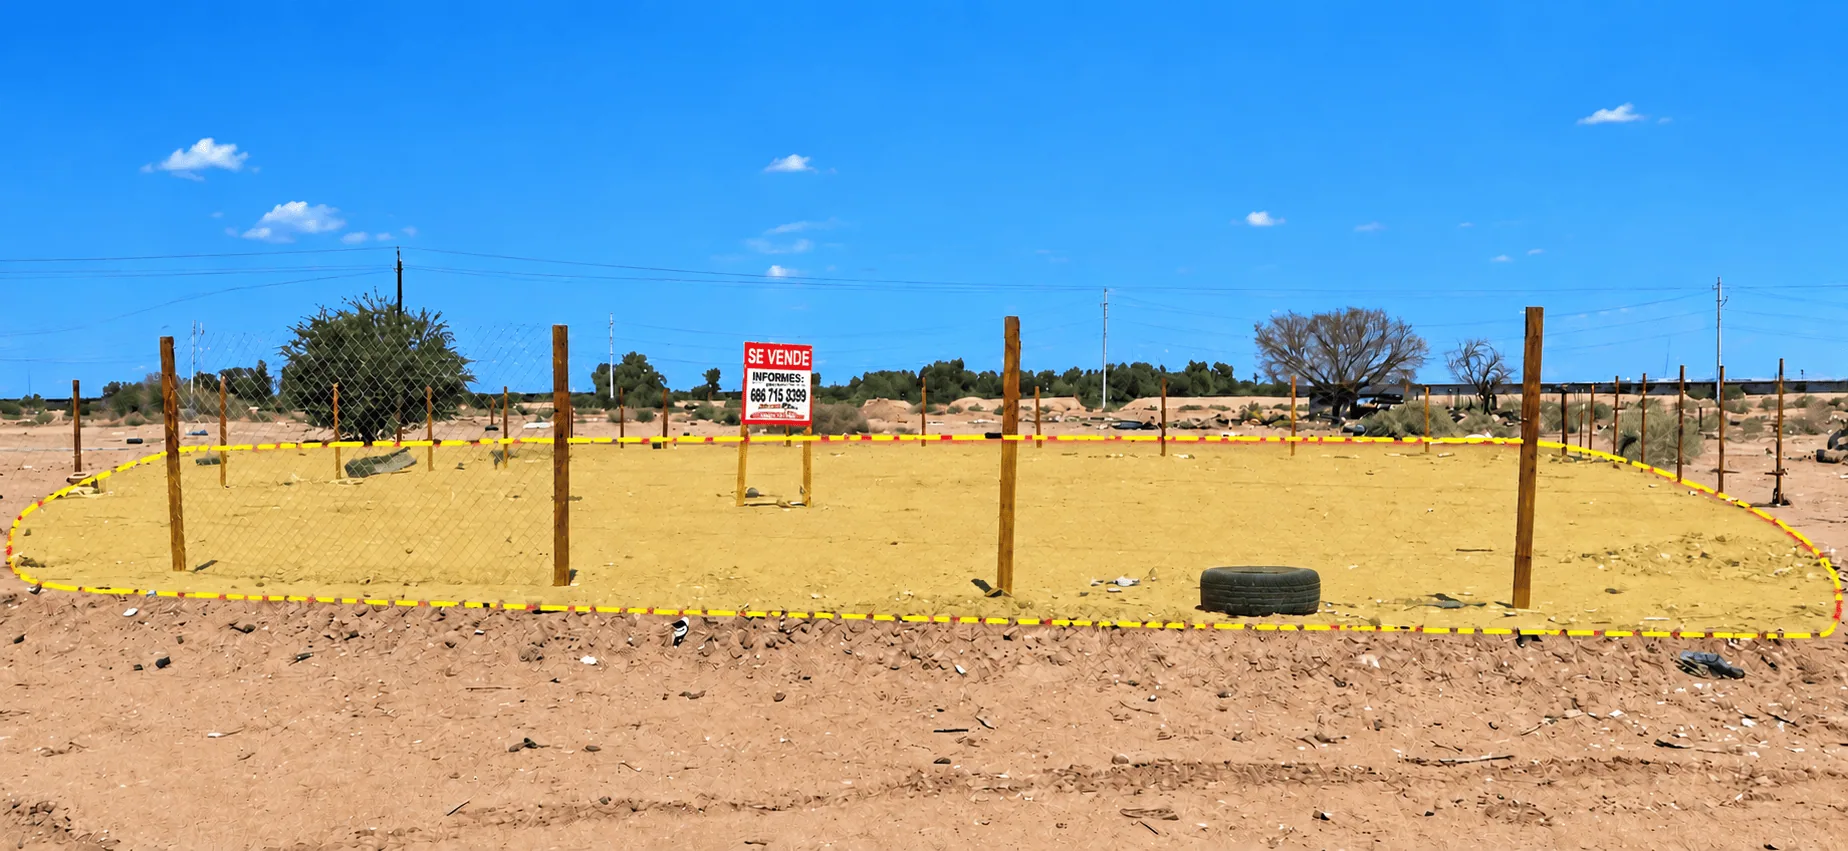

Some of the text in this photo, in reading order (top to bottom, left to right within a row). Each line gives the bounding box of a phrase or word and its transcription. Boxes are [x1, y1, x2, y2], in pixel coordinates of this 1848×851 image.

[748, 348, 810, 367] SE VENDE
[752, 371, 804, 383] INFORMES:
[750, 387, 766, 402] 686
[768, 387, 783, 402] 715
